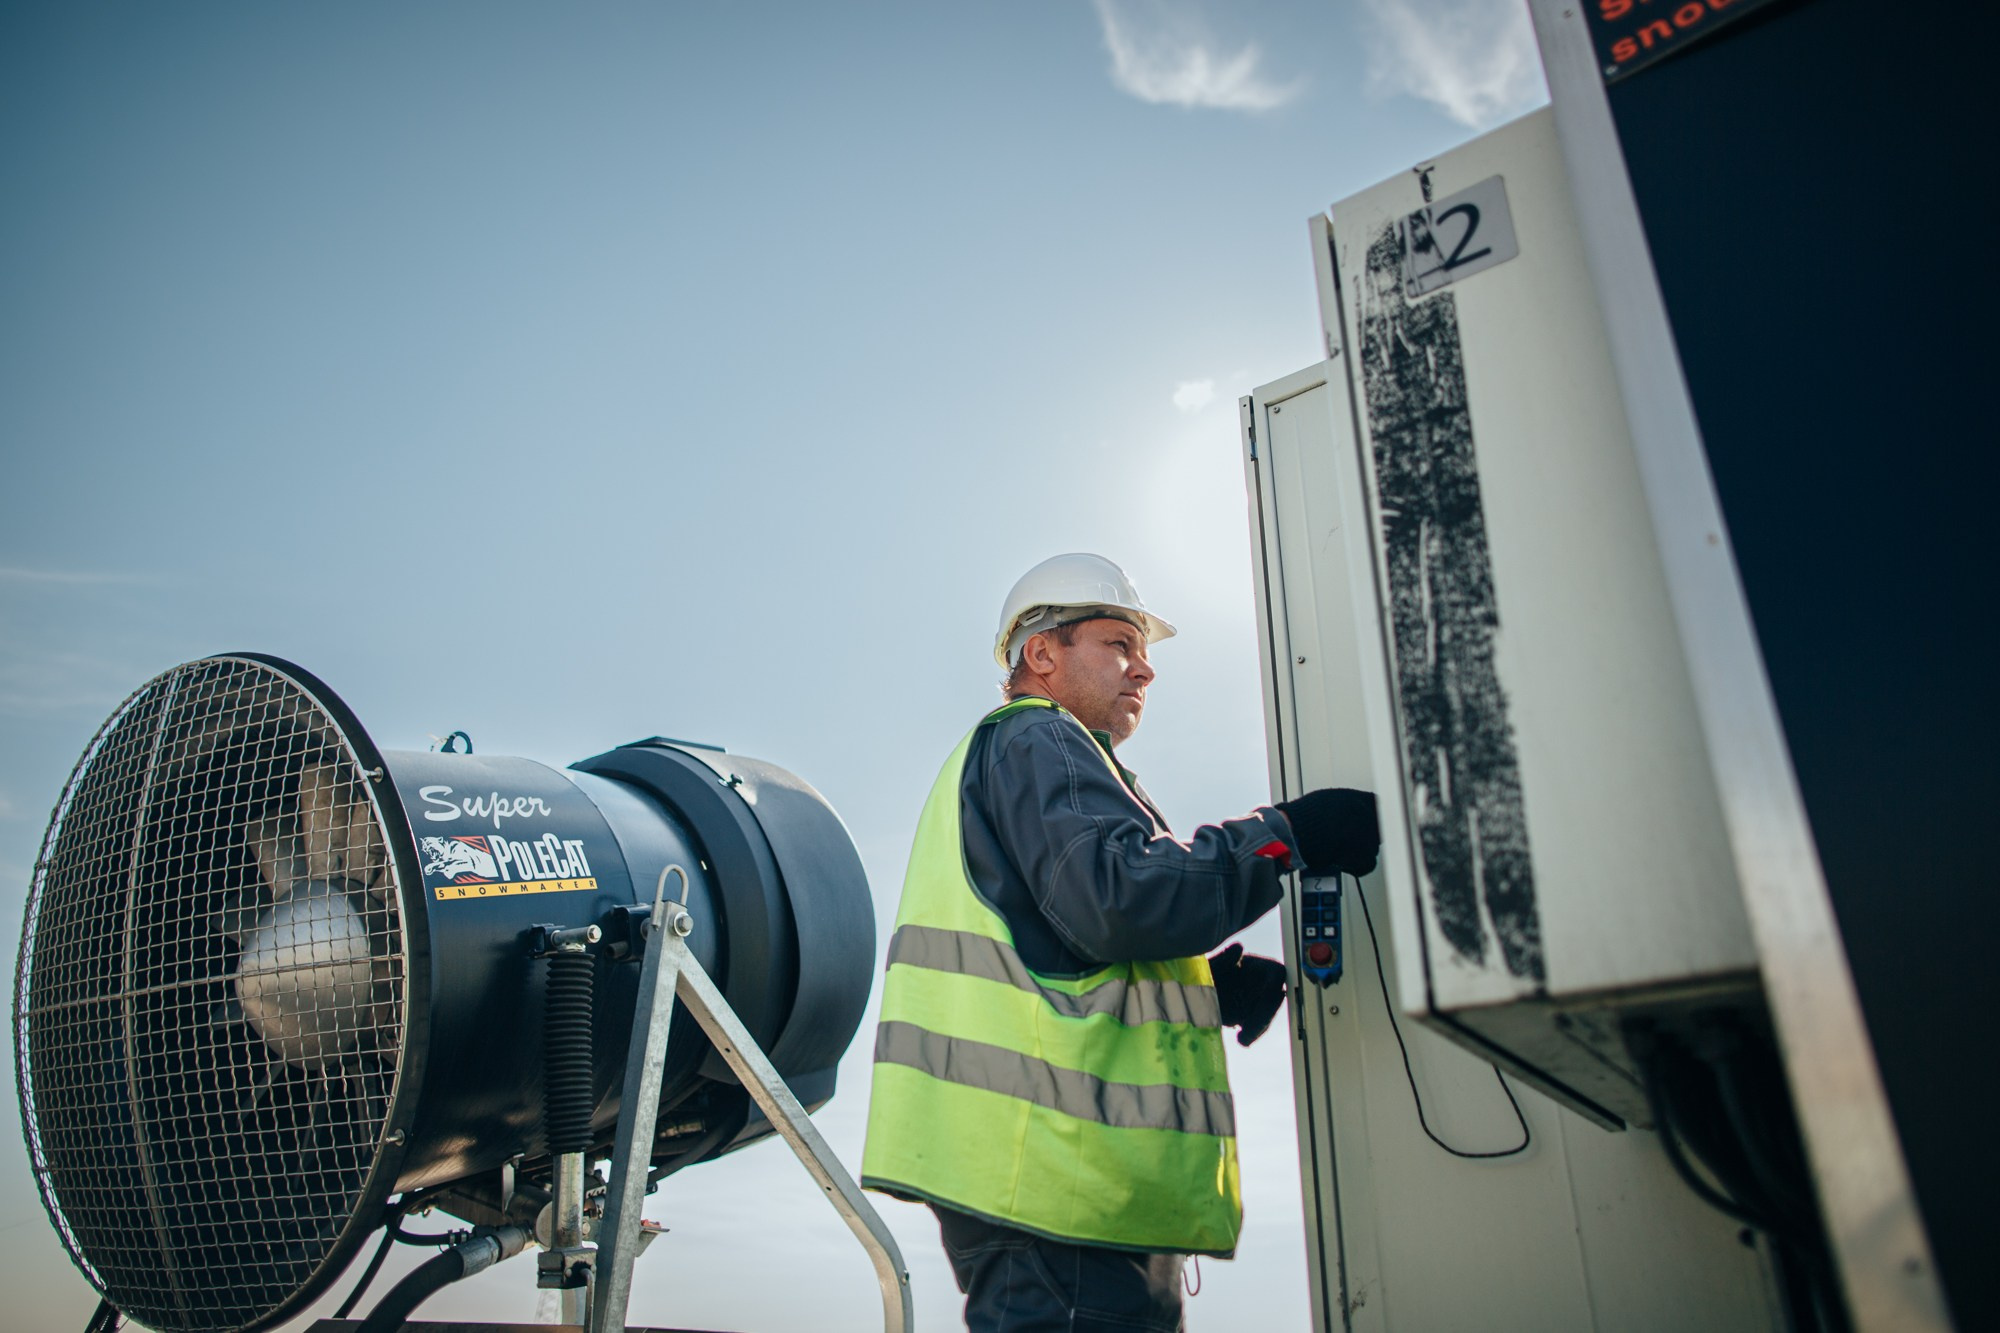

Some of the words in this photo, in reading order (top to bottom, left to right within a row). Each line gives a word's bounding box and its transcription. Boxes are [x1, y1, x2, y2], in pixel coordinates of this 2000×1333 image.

[1436, 203, 1492, 272] 2
[419, 785, 551, 829] Super
[439, 880, 595, 898] SNOWMAKER
